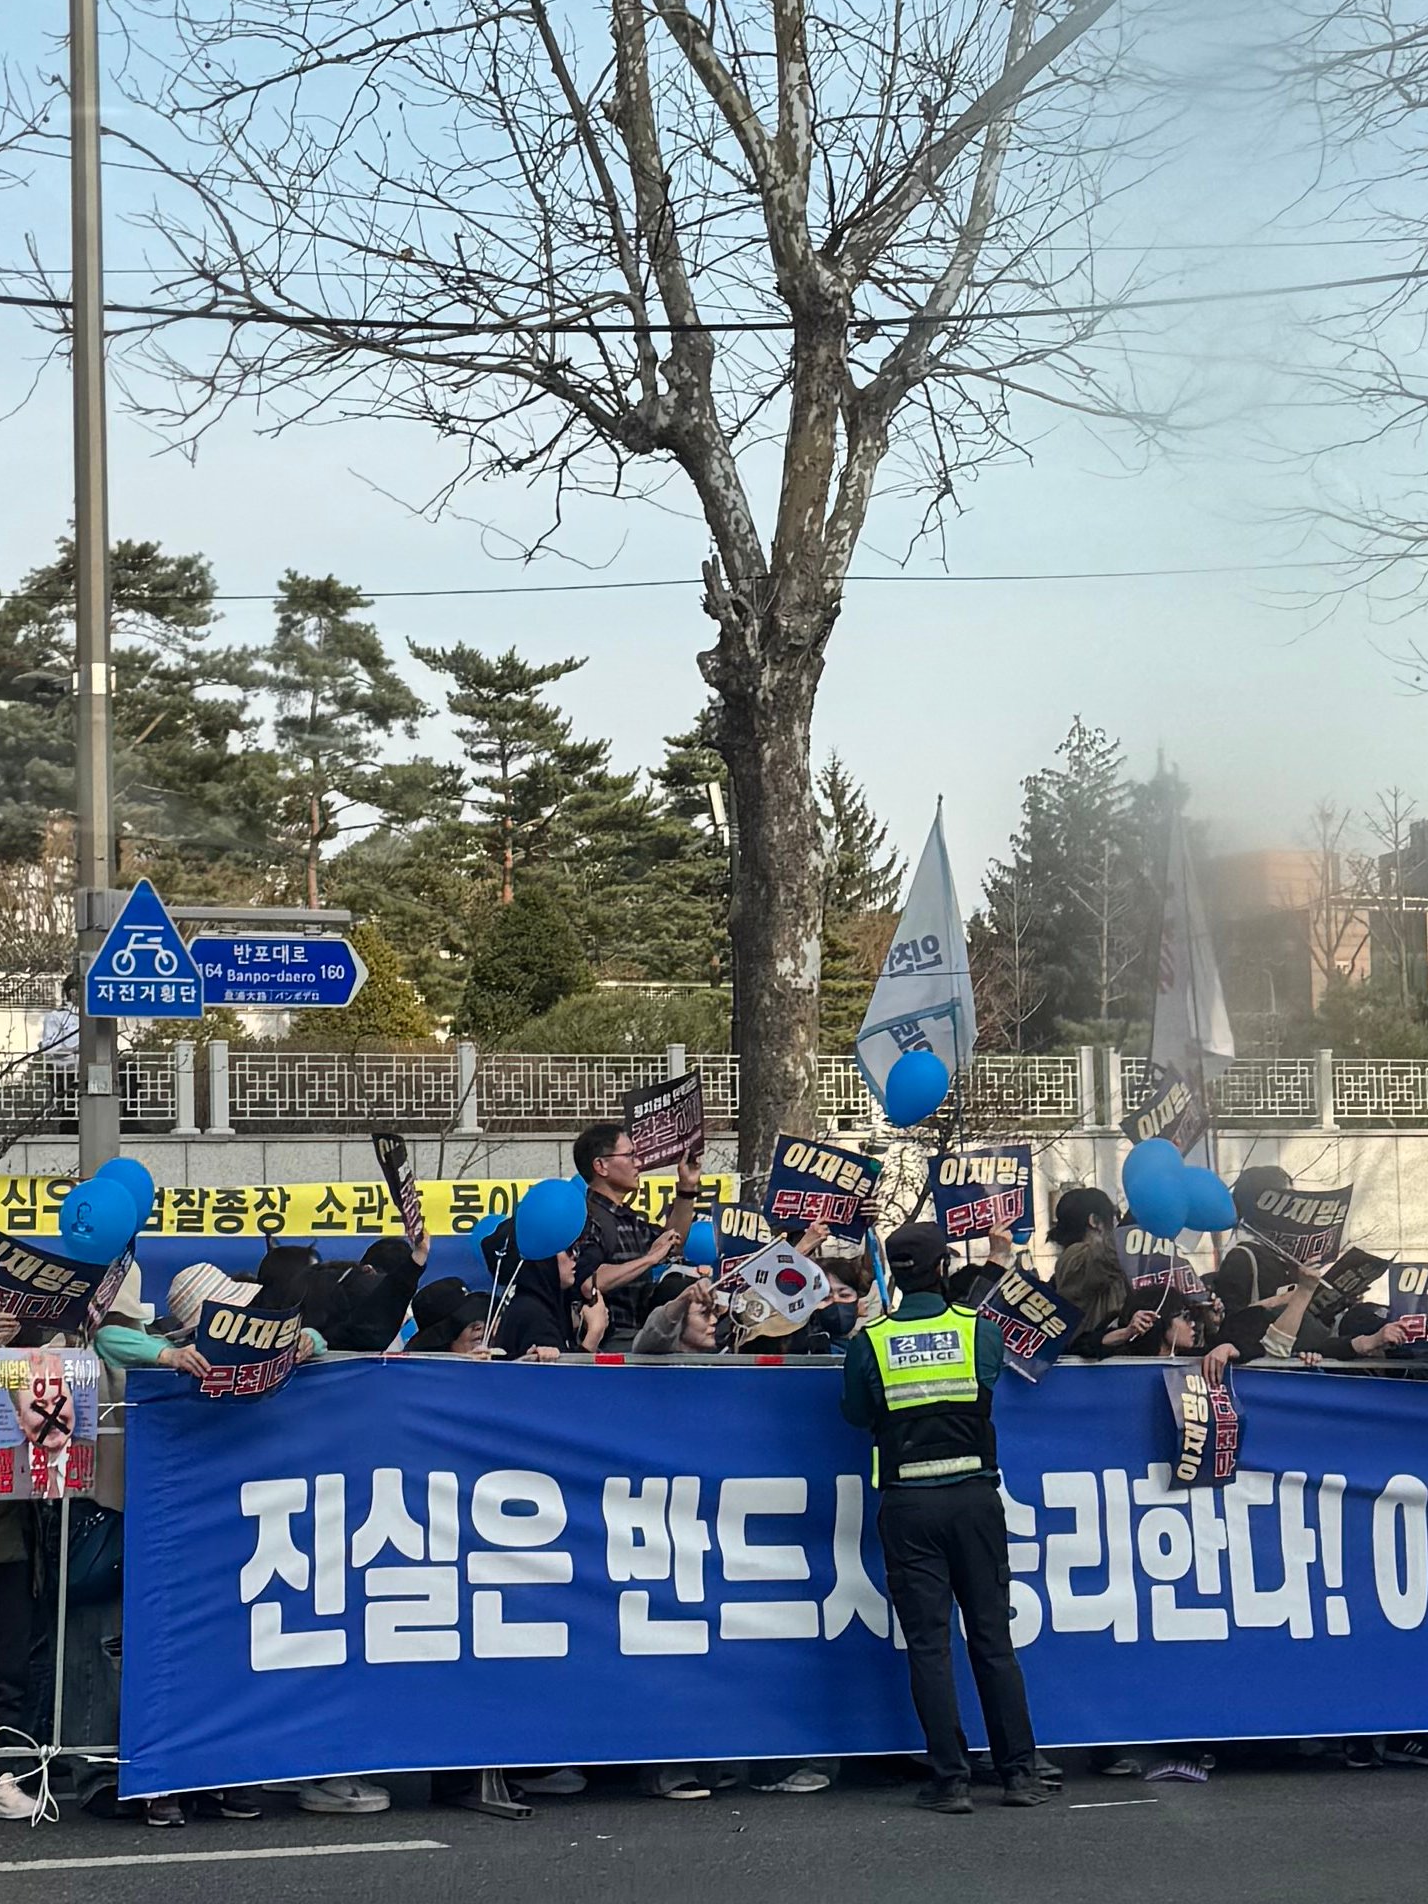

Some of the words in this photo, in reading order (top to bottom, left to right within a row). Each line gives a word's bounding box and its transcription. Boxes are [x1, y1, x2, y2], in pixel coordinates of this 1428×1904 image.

[233, 944, 309, 965] 반포대로
[227, 969, 316, 984] Banpo-daero
[320, 964, 345, 980] 160
[97, 982, 197, 1004] 자전거횡단
[783, 1142, 872, 1197] 이재명은
[939, 1156, 1029, 1186] 이재명은
[897, 1350, 956, 1365] POLICE
[239, 1467, 573, 1672] 진실은
